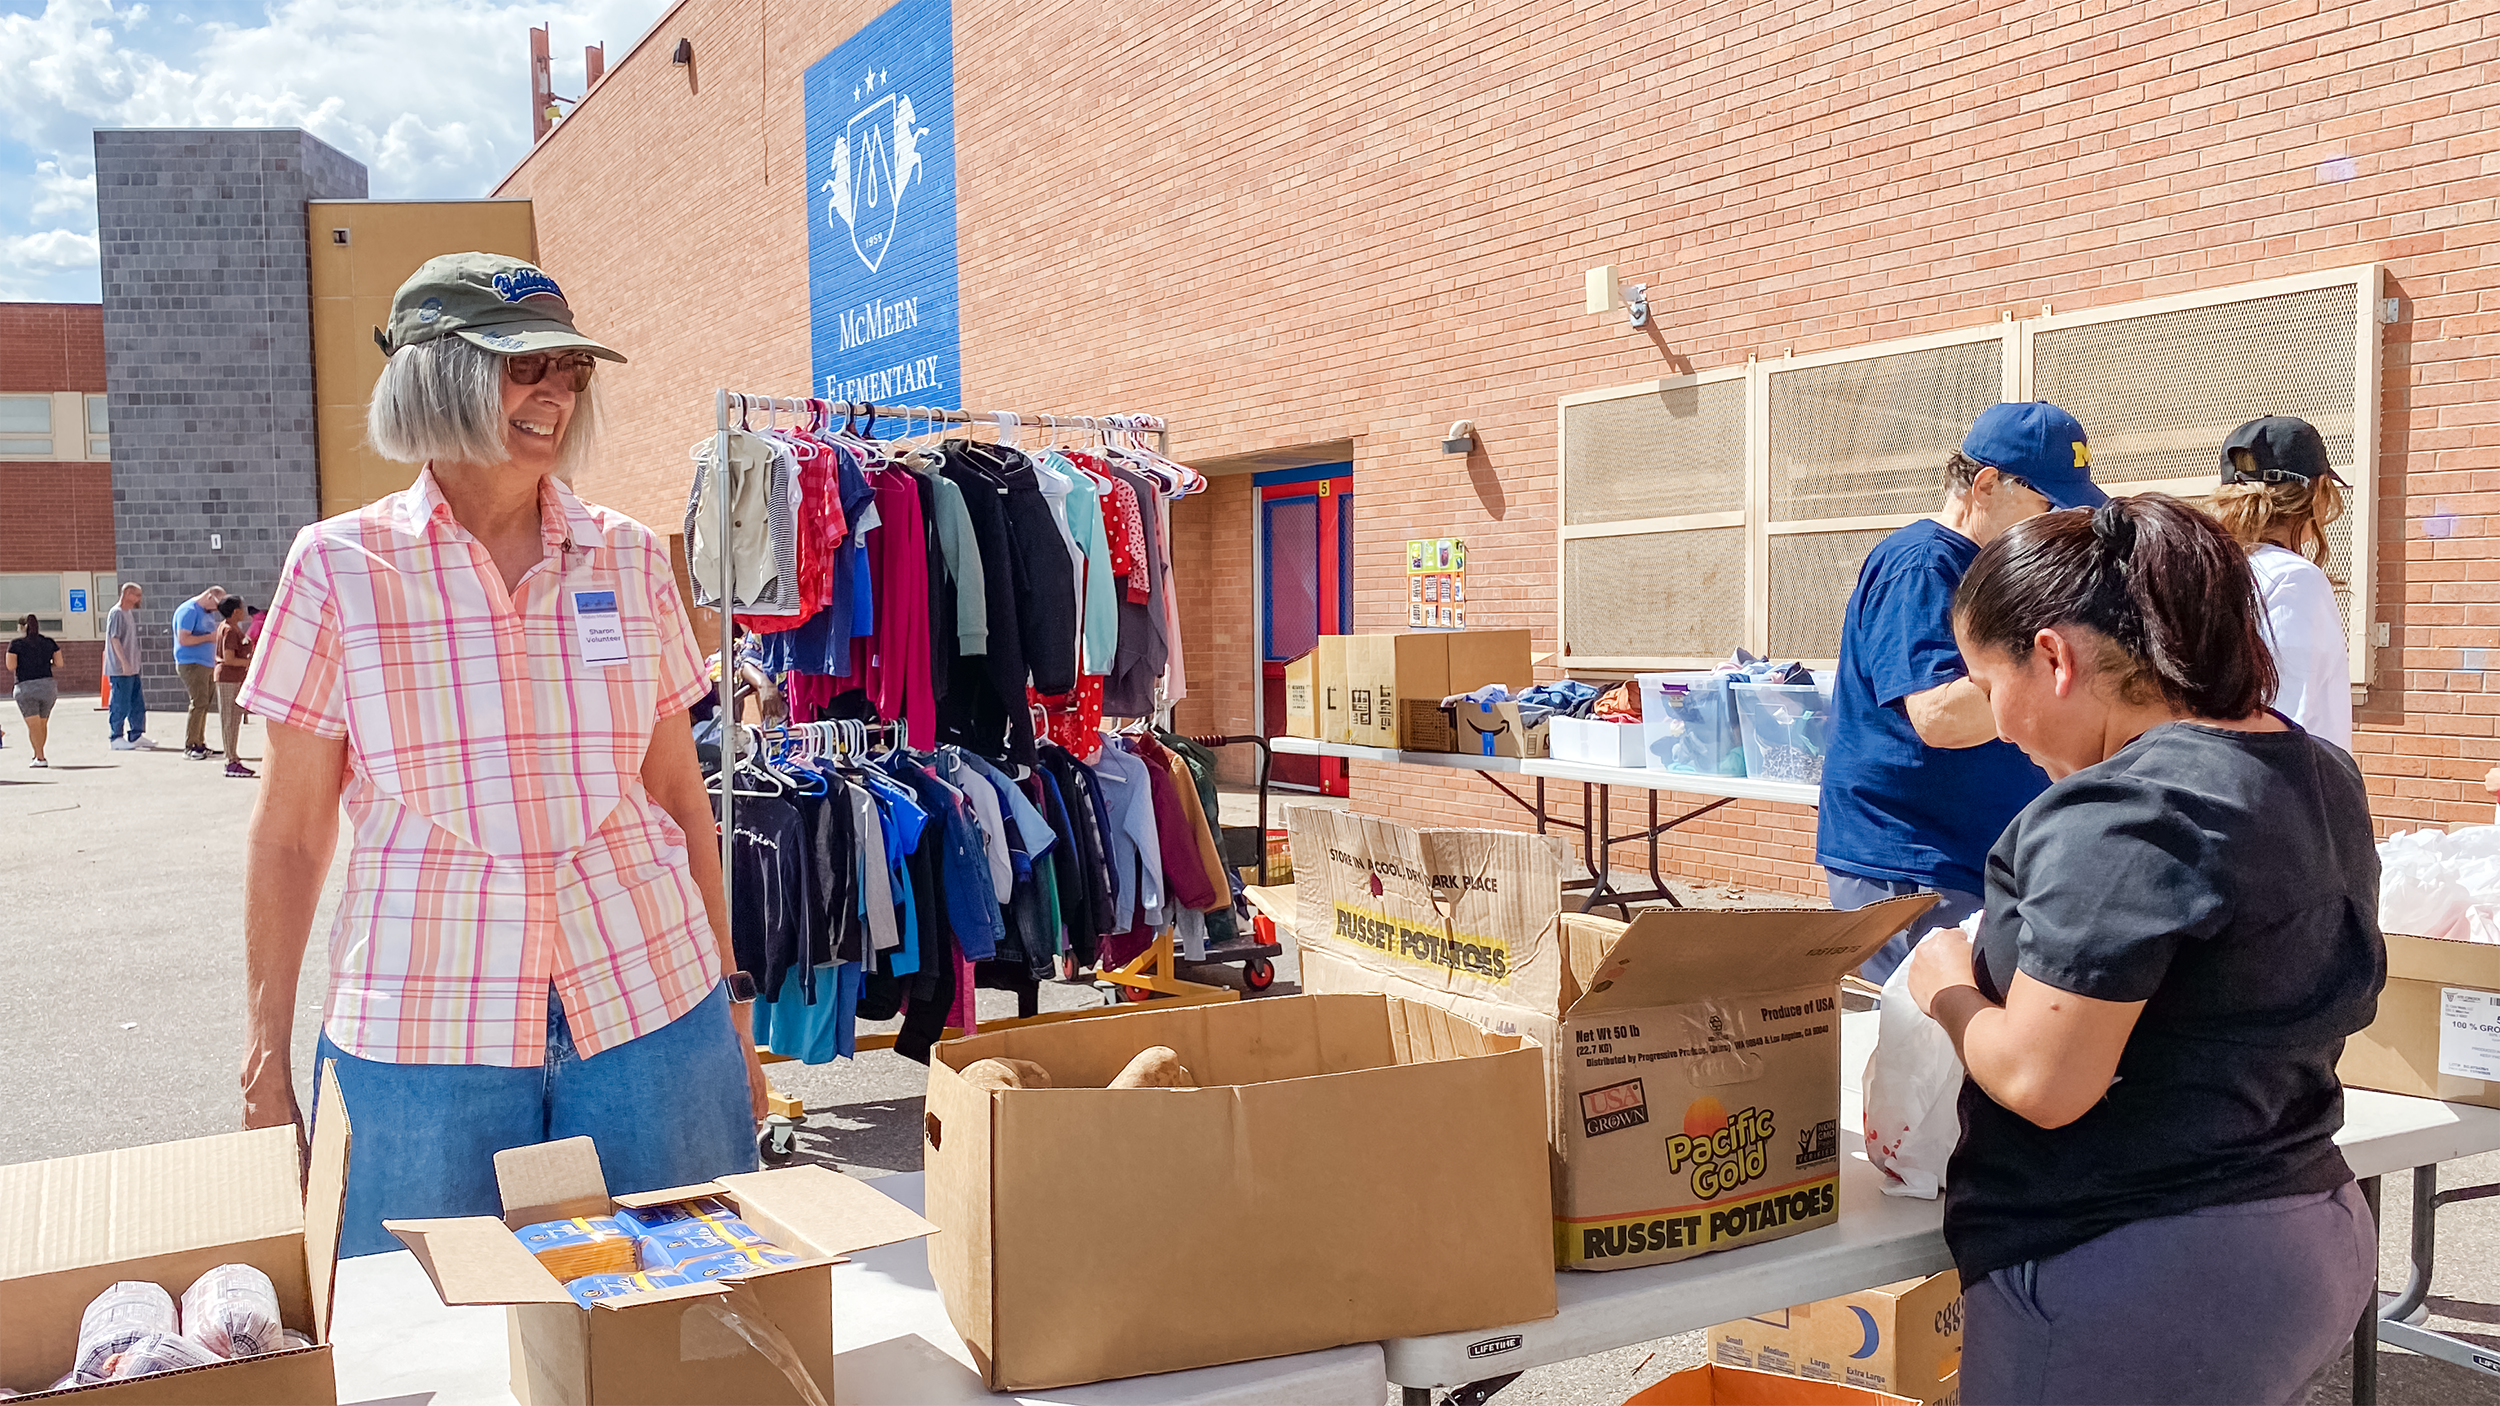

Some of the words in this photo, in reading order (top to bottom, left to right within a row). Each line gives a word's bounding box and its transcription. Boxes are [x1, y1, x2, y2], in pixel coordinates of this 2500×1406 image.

[865, 232, 883, 248] 1959
[826, 355, 938, 404] ELEMENTARY
[1321, 482, 1327, 494] 5
[586, 635, 621, 643] Volunteer
[1330, 848, 1352, 867] STORE
[1353, 856, 1365, 870] IN
[1375, 860, 1406, 880] COOL,
[1462, 875, 1498, 893] PLACE
[1336, 909, 1395, 952] RUSSET
[1399, 927, 1507, 979] POTATOES
[1761, 1005, 1802, 1021] Produce
[1804, 1000, 1813, 1014] of
[1816, 997, 1834, 1012] USA
[2452, 1021, 2467, 1029] 100
[1576, 1029, 1594, 1042] Net
[1597, 1027, 1612, 1040] Wt
[1614, 1025, 1627, 1039] 50
[1630, 1025, 1640, 1037] lb
[1576, 1045, 1596, 1057] (22.7
[1599, 1043, 1612, 1054] KG)
[1586, 1055, 1626, 1067] Distributed
[1628, 1054, 1636, 1064] by
[1638, 1050, 1677, 1062] Progressive
[1734, 1041, 1745, 1050] WA
[1804, 1028, 1812, 1036] CA
[1587, 1108, 1645, 1134] GROWN
[1818, 1121, 1835, 1131] NON
[1665, 1107, 1775, 1174] Pacific
[1818, 1130, 1835, 1140] GMO
[1798, 1148, 1835, 1162] VERIFIED
[1691, 1140, 1767, 1200] Gold
[1583, 1215, 1702, 1259] RUSSET
[1710, 1184, 1834, 1242] POTATOES
[1474, 1339, 1516, 1354] LIFETIME
[1725, 1335, 1743, 1346] Small
[1763, 1345, 1789, 1358] Medium
[1810, 1357, 1830, 1369] Large
[1847, 1367, 1865, 1377] Extra
[1866, 1372, 1885, 1383] Large
